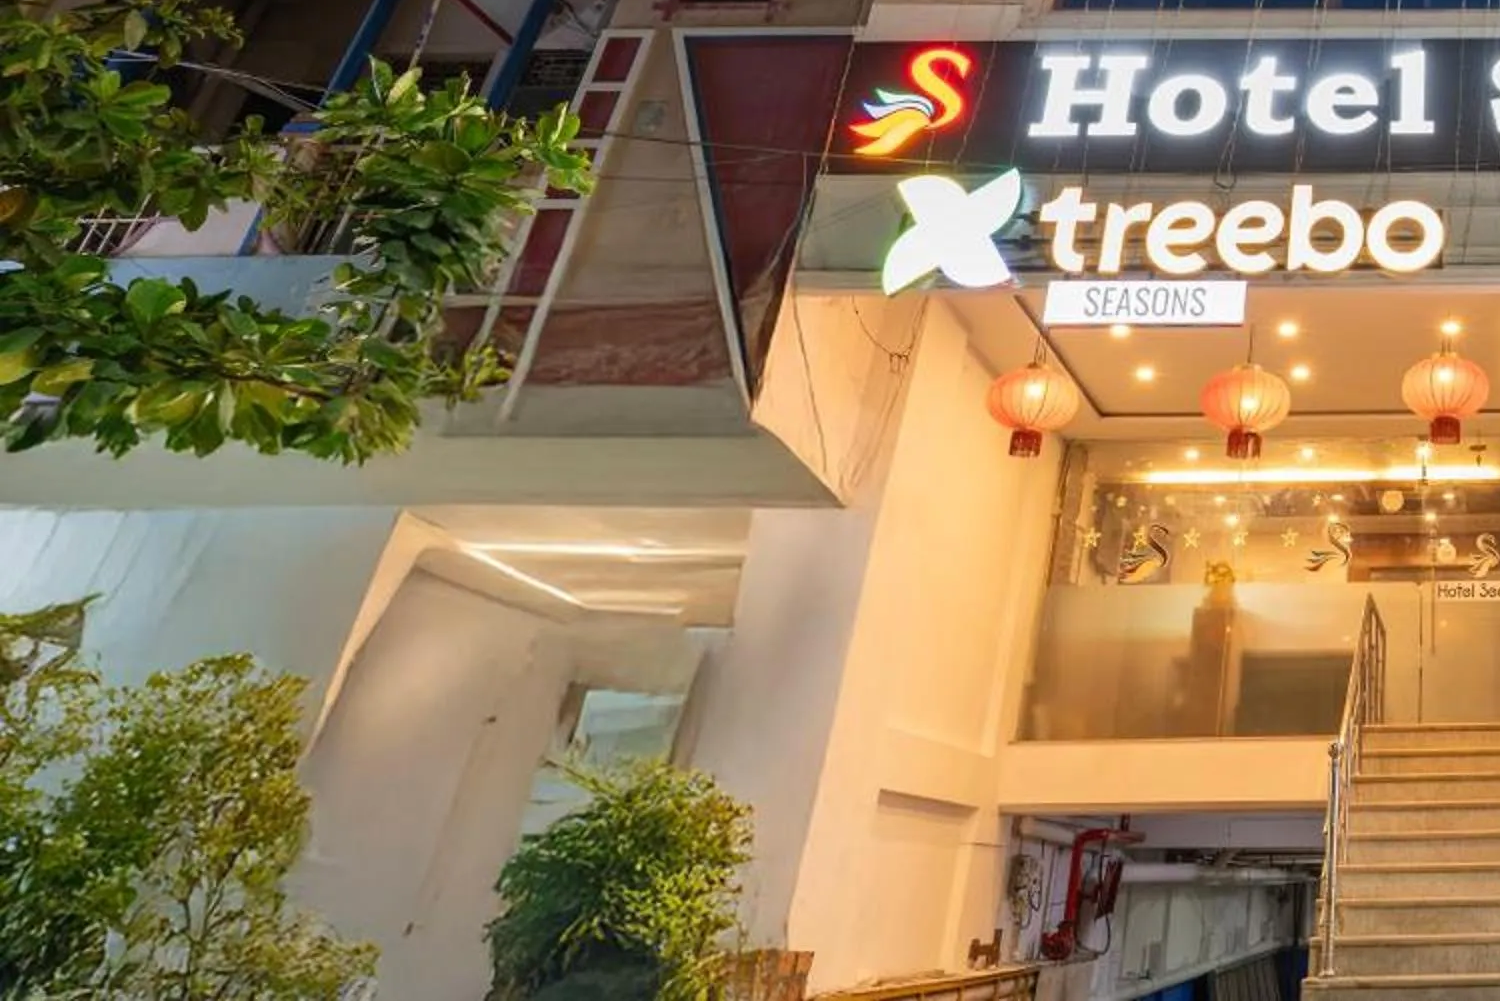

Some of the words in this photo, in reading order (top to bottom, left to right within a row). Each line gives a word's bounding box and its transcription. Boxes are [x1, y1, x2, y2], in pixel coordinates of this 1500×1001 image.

[1027, 49, 1434, 138] Hotel
[1040, 185, 1444, 274] treebo
[1084, 287, 1207, 317] SEASONS
[1437, 583, 1475, 598] Hotel
